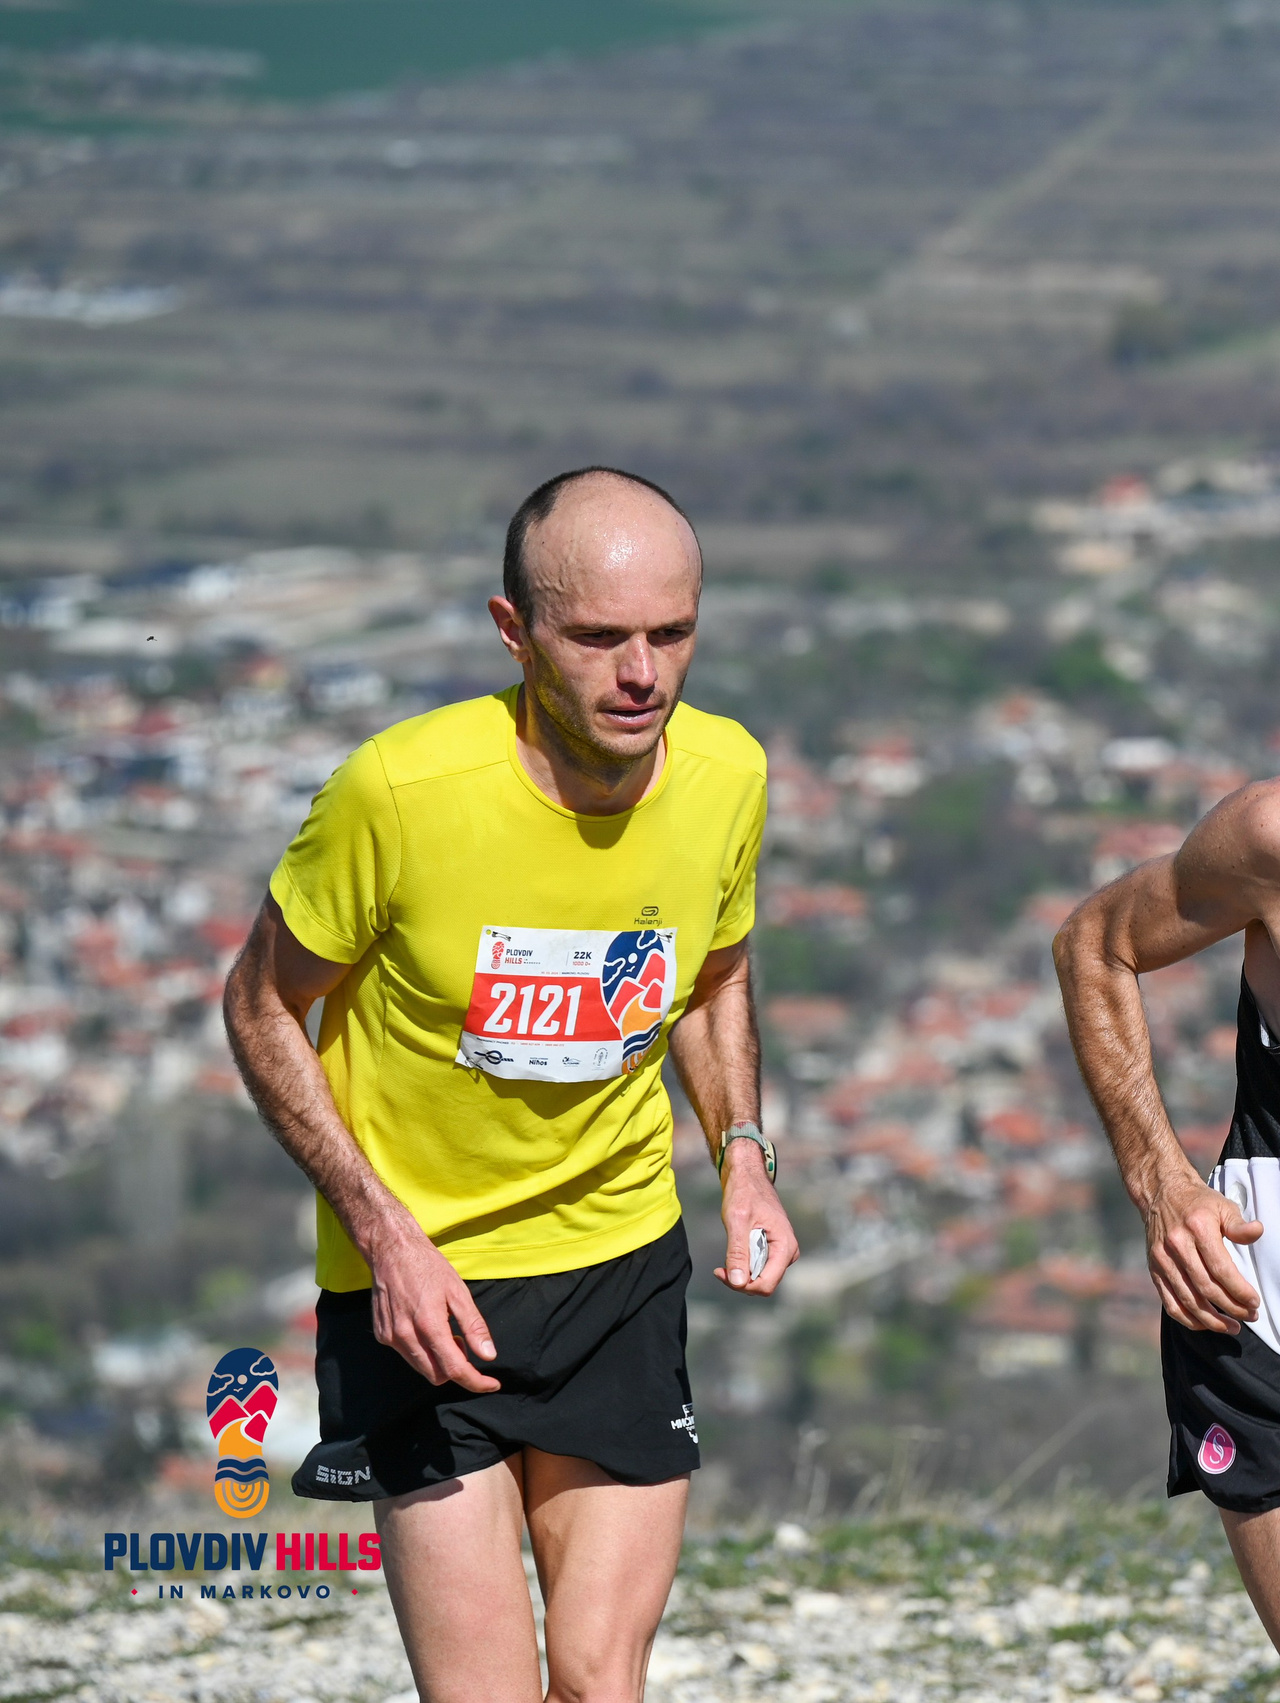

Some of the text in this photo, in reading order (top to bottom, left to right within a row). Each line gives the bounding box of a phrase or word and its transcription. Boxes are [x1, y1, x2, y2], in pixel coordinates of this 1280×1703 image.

[634, 918, 663, 927] Kalenji
[506, 949, 533, 957] PLOVDIV
[573, 951, 592, 960] 22K
[504, 957, 523, 965] HILLS
[482, 982, 583, 1036] 2121
